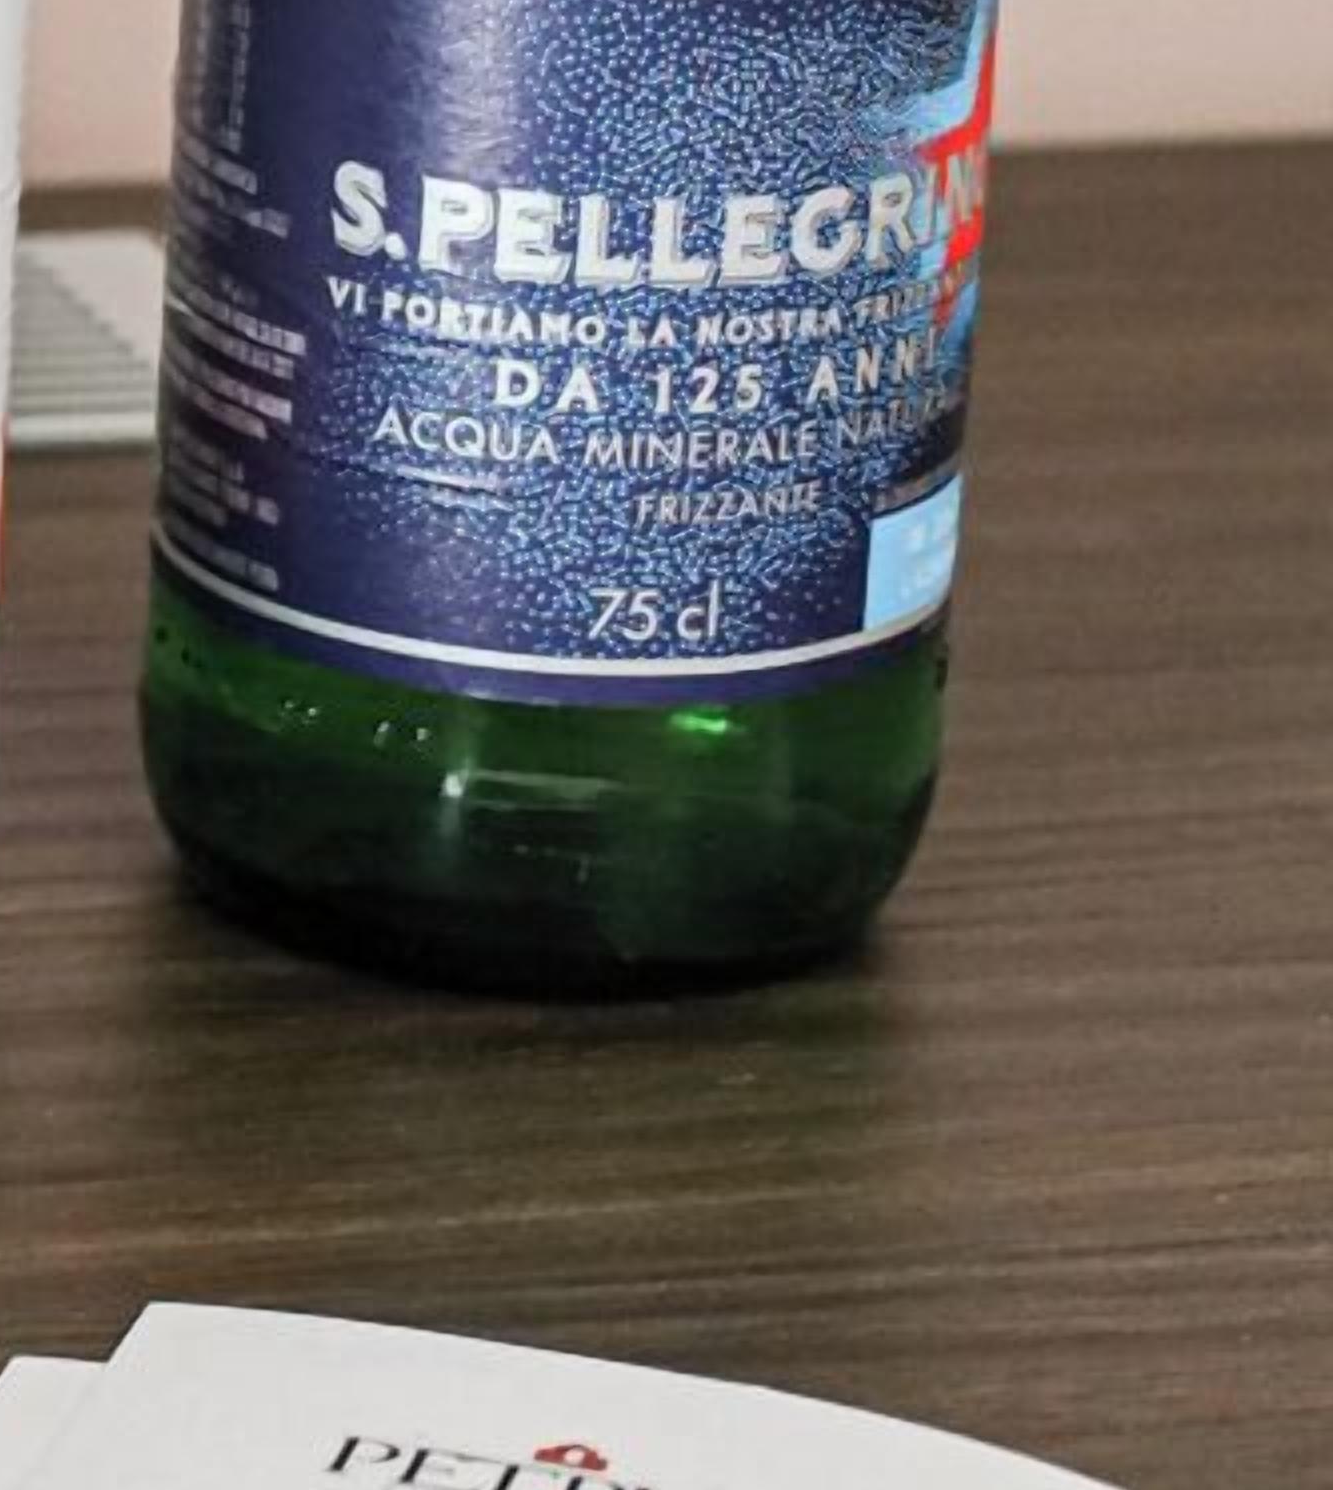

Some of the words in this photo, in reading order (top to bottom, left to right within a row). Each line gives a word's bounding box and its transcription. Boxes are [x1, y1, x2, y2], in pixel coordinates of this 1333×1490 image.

[327, 276, 367, 316] VI
[627, 310, 679, 350] LA
[696, 306, 843, 348] NOSTRA
[491, 356, 601, 414] DA
[645, 362, 765, 417] 125
[369, 404, 563, 465] ACQUA
[579, 416, 819, 472] MINERALE
[635, 479, 825, 526] FRIZZANTE
[586, 586, 665, 642] 75
[676, 578, 721, 642] cl
